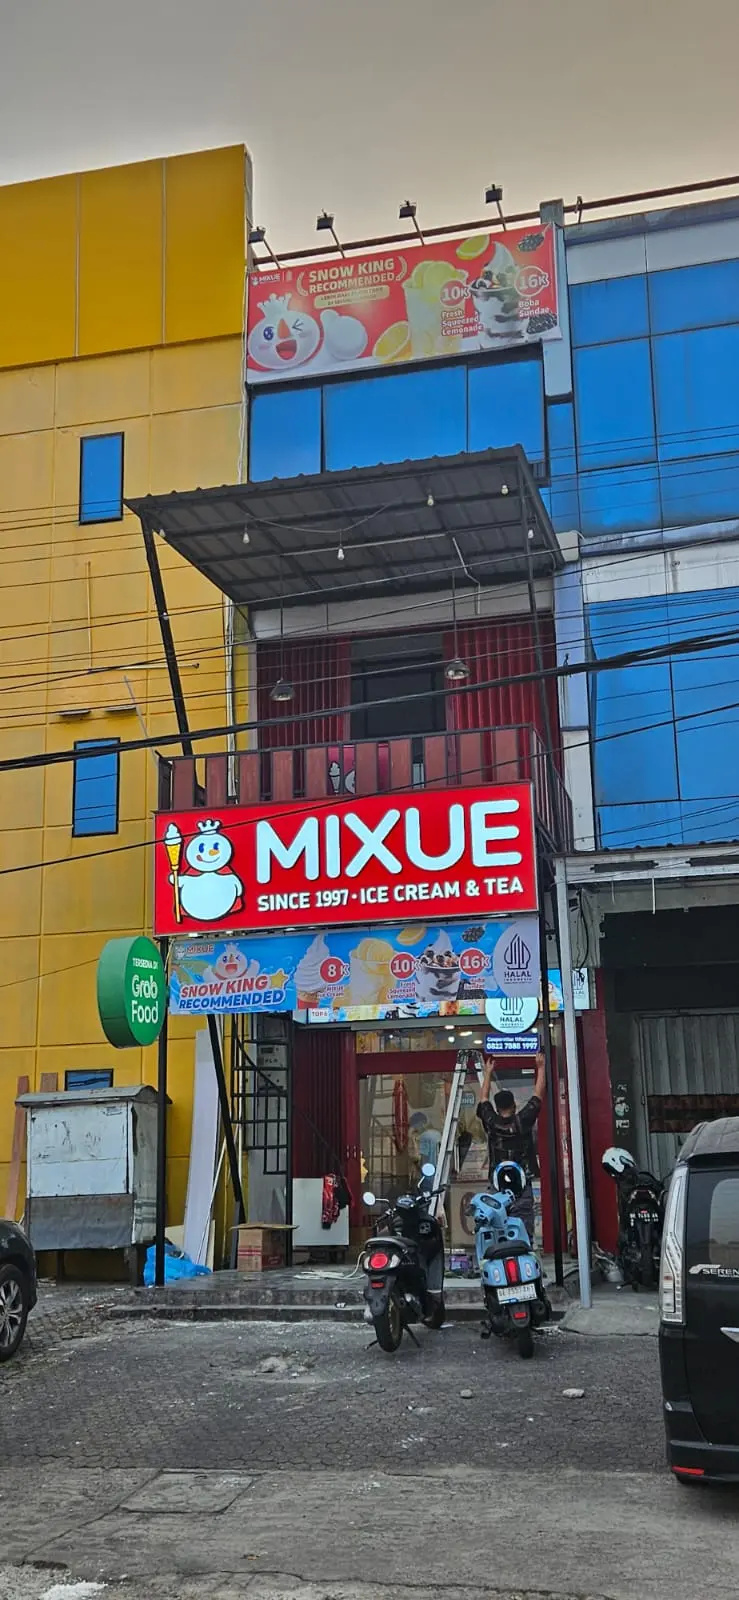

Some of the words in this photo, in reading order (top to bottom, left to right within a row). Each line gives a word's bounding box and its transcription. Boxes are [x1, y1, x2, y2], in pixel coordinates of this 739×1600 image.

[309, 265, 354, 283] SNOW
[358, 258, 395, 275] KING
[309, 272, 395, 294] RECOMMENDED
[520, 273, 549, 290] 16K
[443, 286, 471, 301] 10K
[442, 309, 464, 319] Fresh
[519, 307, 550, 318] Sundae
[442, 324, 484, 336] Lemonade
[256, 799, 523, 884] MIXUE
[257, 892, 311, 912] SINCE
[315, 889, 349, 907] 1997
[360, 886, 389, 904] ICE
[394, 880, 460, 902] CREAM
[465, 879, 480, 897] &
[484, 876, 524, 896] TEA
[463, 955, 490, 969] 16K
[131, 974, 158, 999] Grab
[181, 982, 224, 998] SNOW
[226, 975, 268, 994] KING
[179, 989, 285, 1009] RECOMMENDED
[131, 999, 159, 1024] Food
[522, 1042, 538, 1050] 1997
